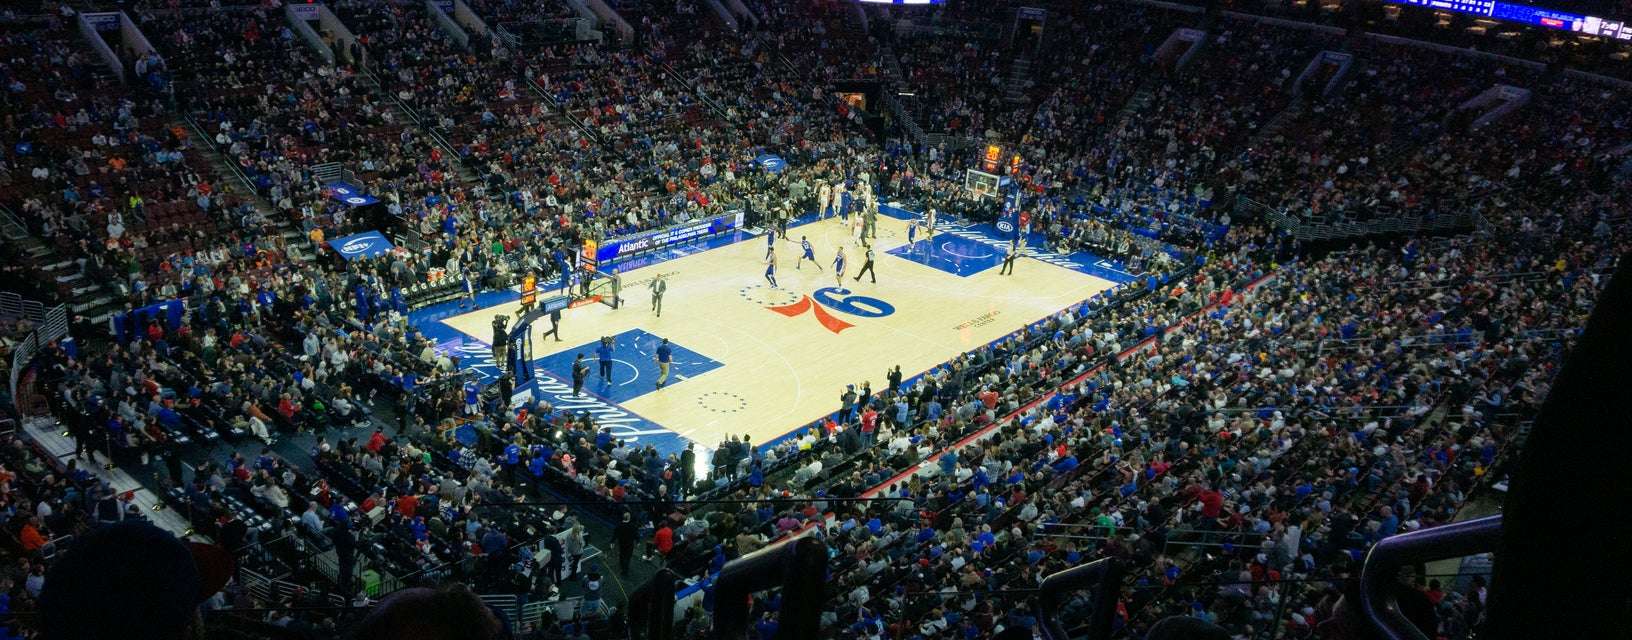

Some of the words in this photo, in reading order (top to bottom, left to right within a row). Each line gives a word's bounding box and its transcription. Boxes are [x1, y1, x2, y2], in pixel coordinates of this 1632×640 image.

[999, 223, 1011, 231] KIA
[669, 231, 697, 242] PHILADELPHIA
[618, 239, 649, 253] Atlantic
